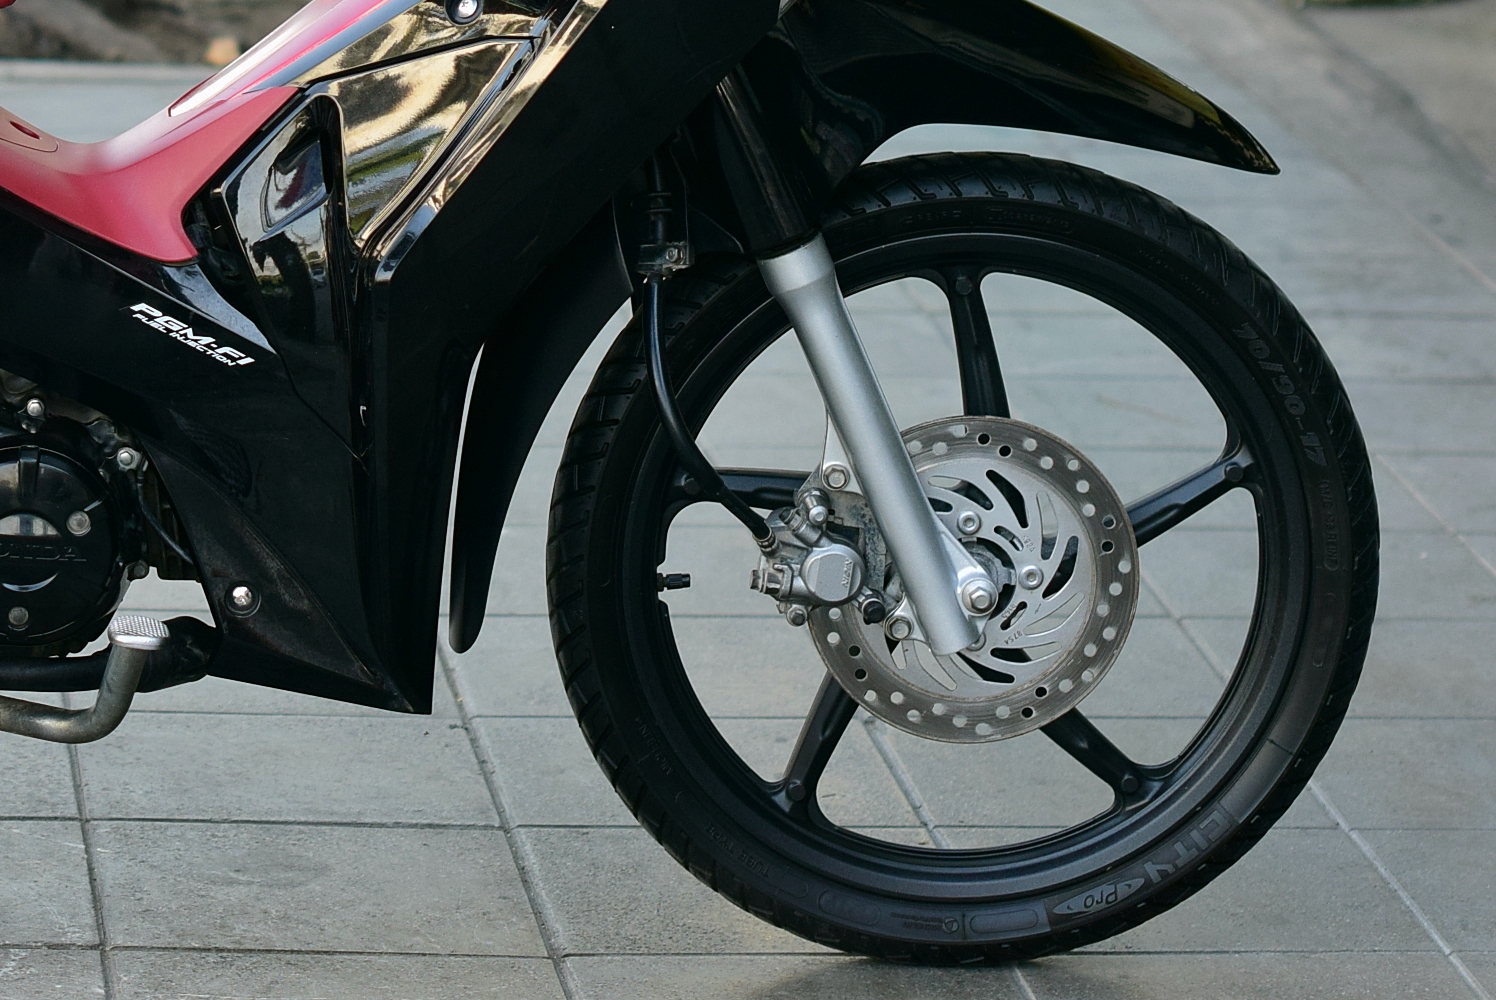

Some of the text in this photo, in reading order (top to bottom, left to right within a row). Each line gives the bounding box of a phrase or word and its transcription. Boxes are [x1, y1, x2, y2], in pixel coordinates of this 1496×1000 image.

[132, 313, 236, 366] FUEL INJECTION
[1083, 808, 1234, 909] CITY Pro
